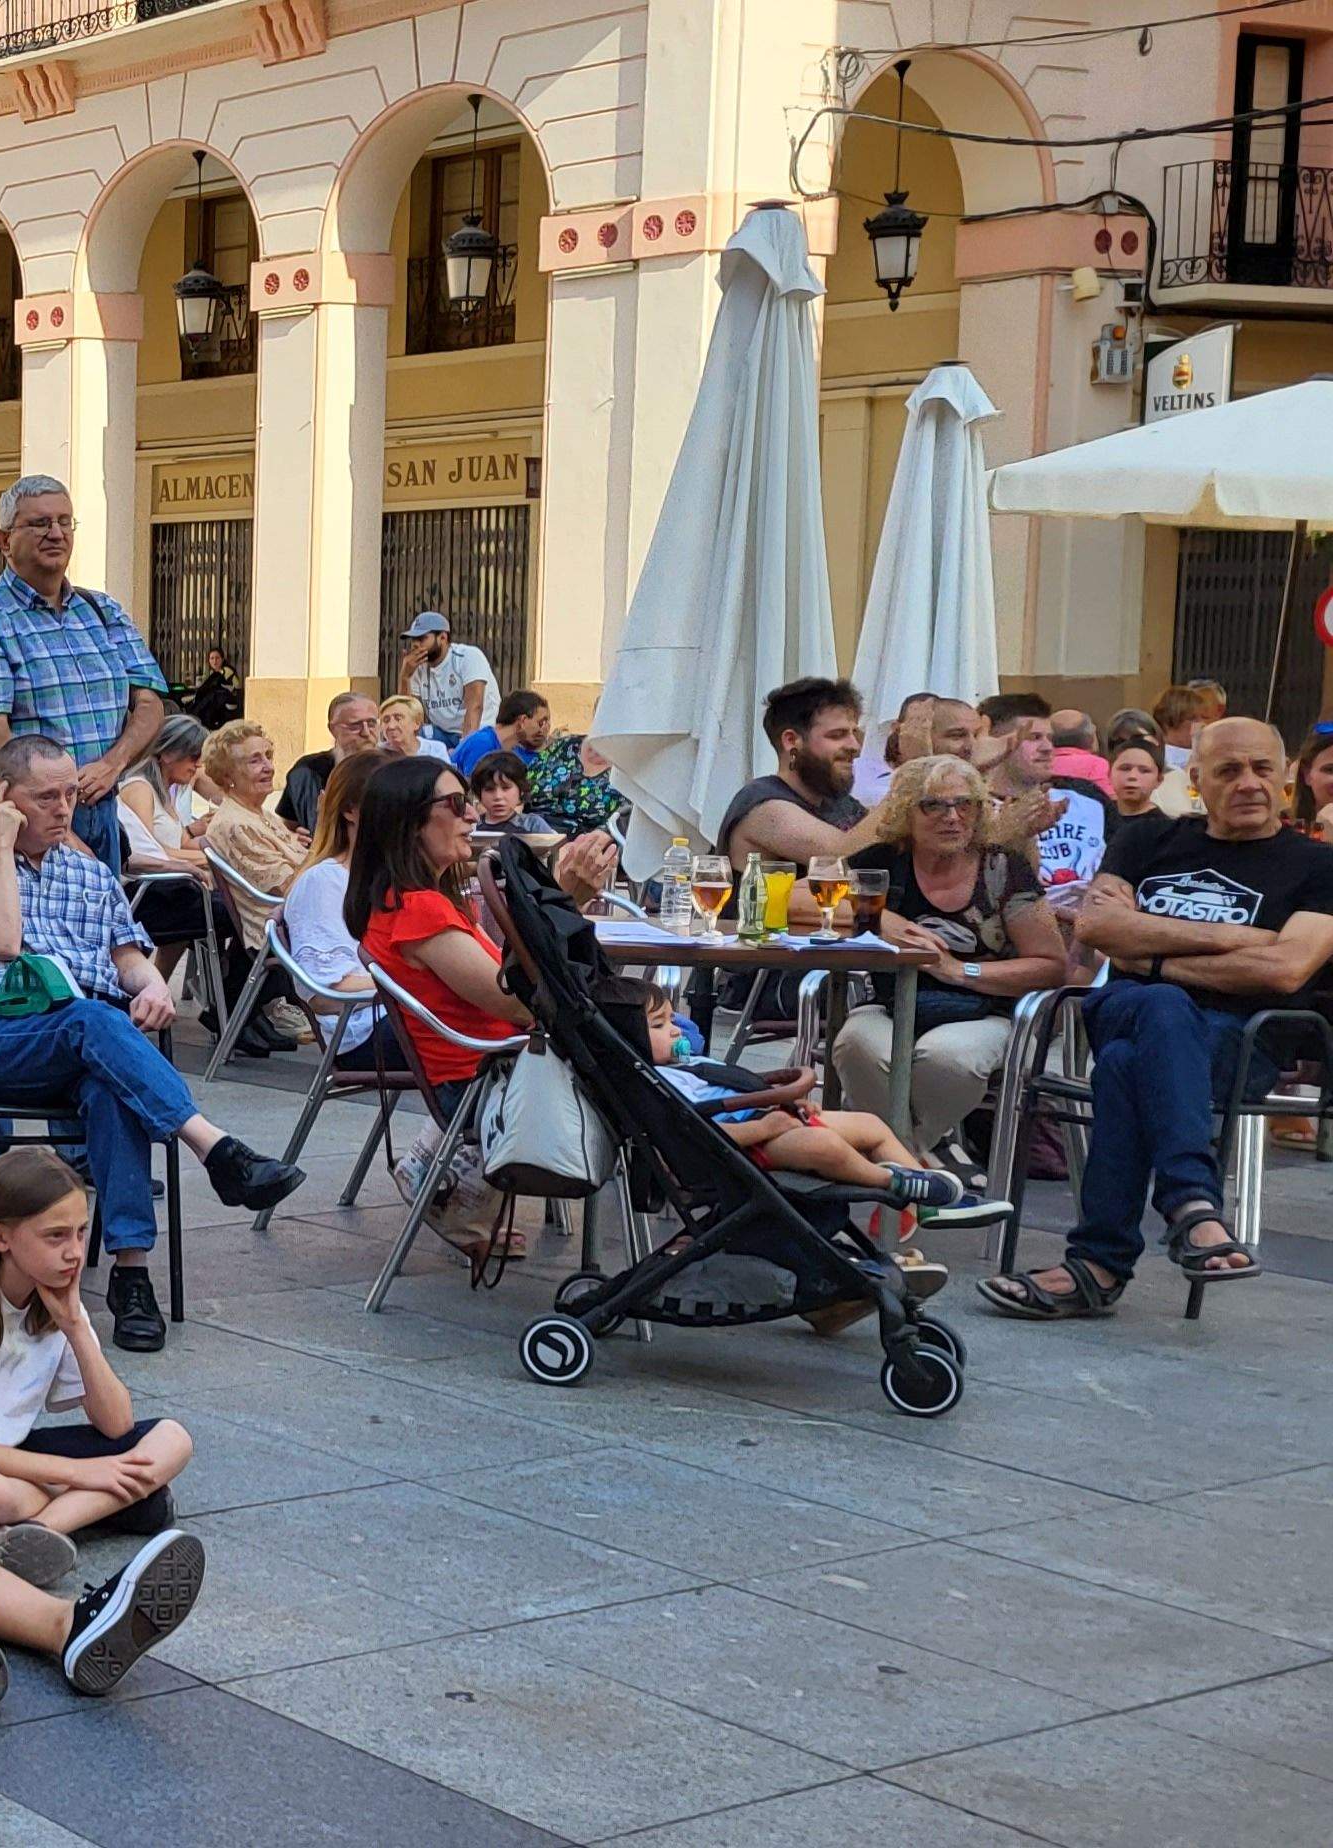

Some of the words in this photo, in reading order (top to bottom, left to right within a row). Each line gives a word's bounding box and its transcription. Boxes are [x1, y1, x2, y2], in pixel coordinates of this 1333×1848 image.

[1153, 392, 1216, 412] VELTINS
[386, 459, 438, 488] SAN
[448, 453, 520, 484] JUAN
[1138, 893, 1250, 925] MOTASTRO
